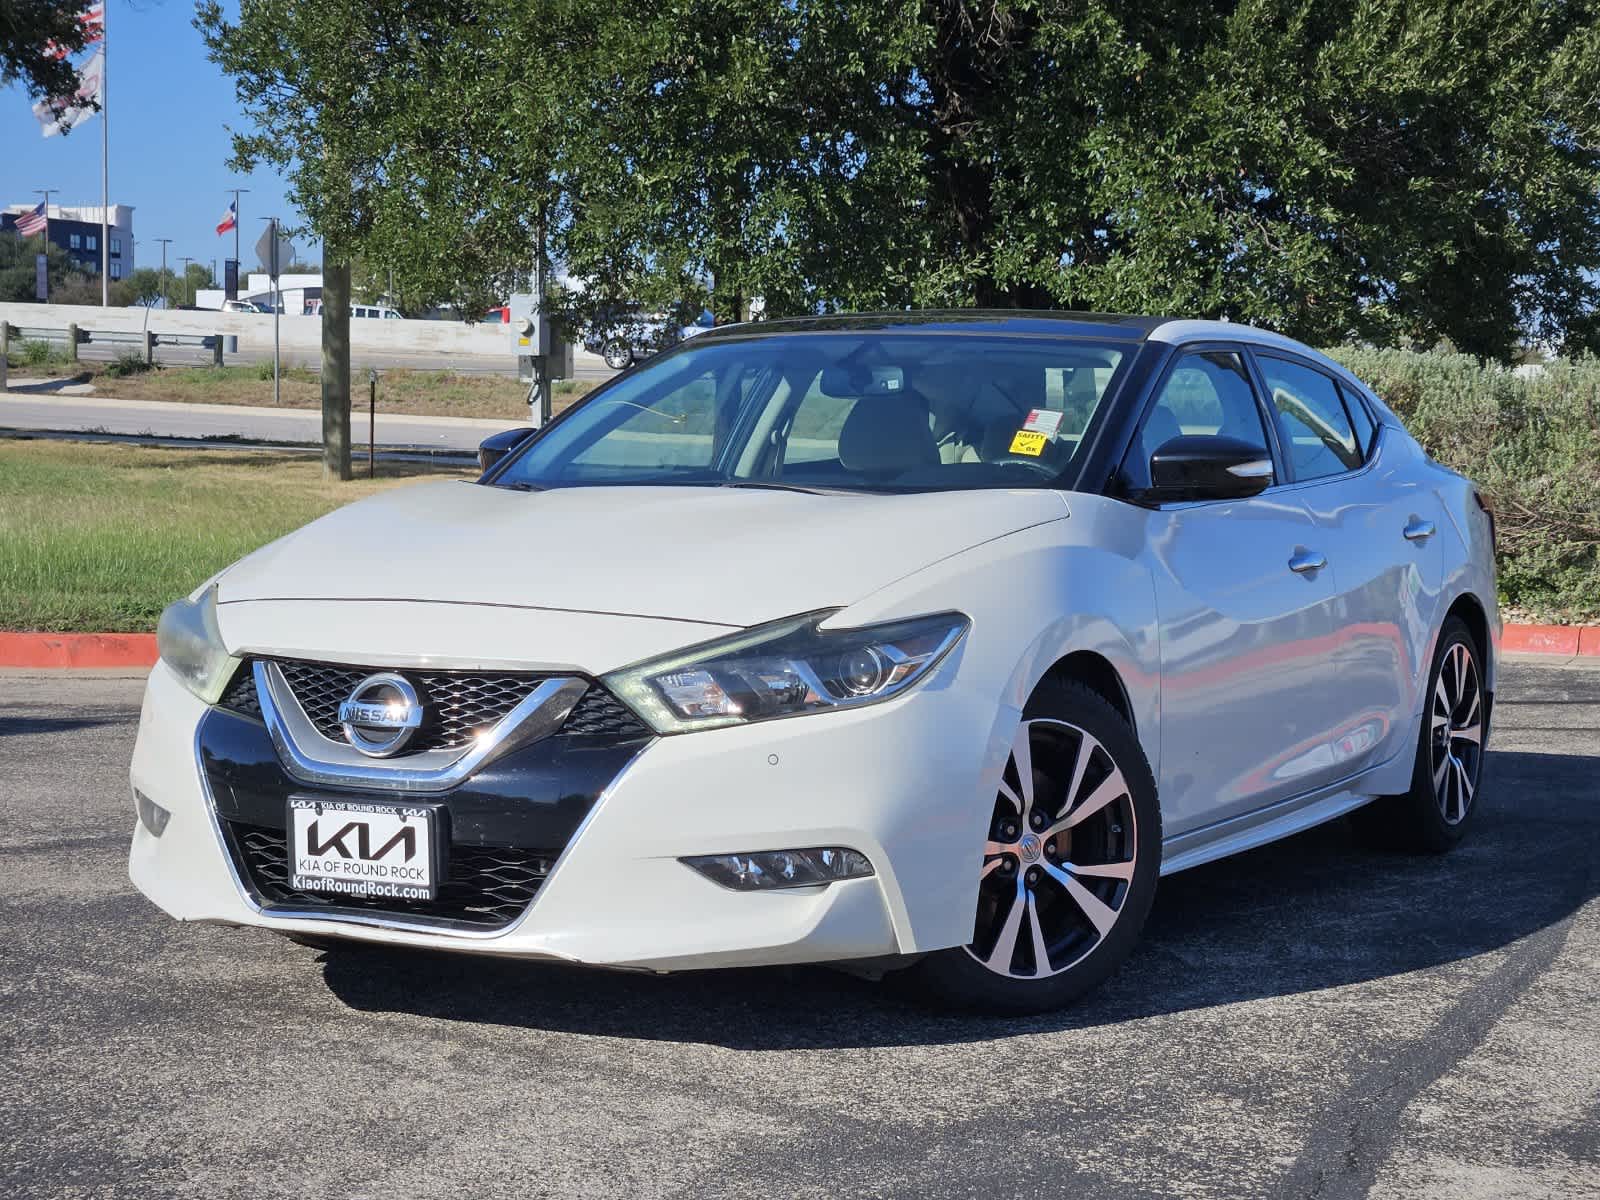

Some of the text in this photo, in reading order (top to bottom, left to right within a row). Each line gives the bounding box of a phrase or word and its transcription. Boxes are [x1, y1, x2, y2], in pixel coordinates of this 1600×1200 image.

[1018, 432, 1044, 440] SAFETY
[344, 705, 409, 722] NISSAN
[290, 800, 317, 809] KIA
[320, 802, 397, 815] KIA OF ROUND ROCK
[403, 808, 427, 816] KIA
[307, 820, 417, 863] KIA
[299, 858, 425, 881] KIA OF ROUND ROCK
[292, 875, 430, 899] KiaofRoundRock.com
